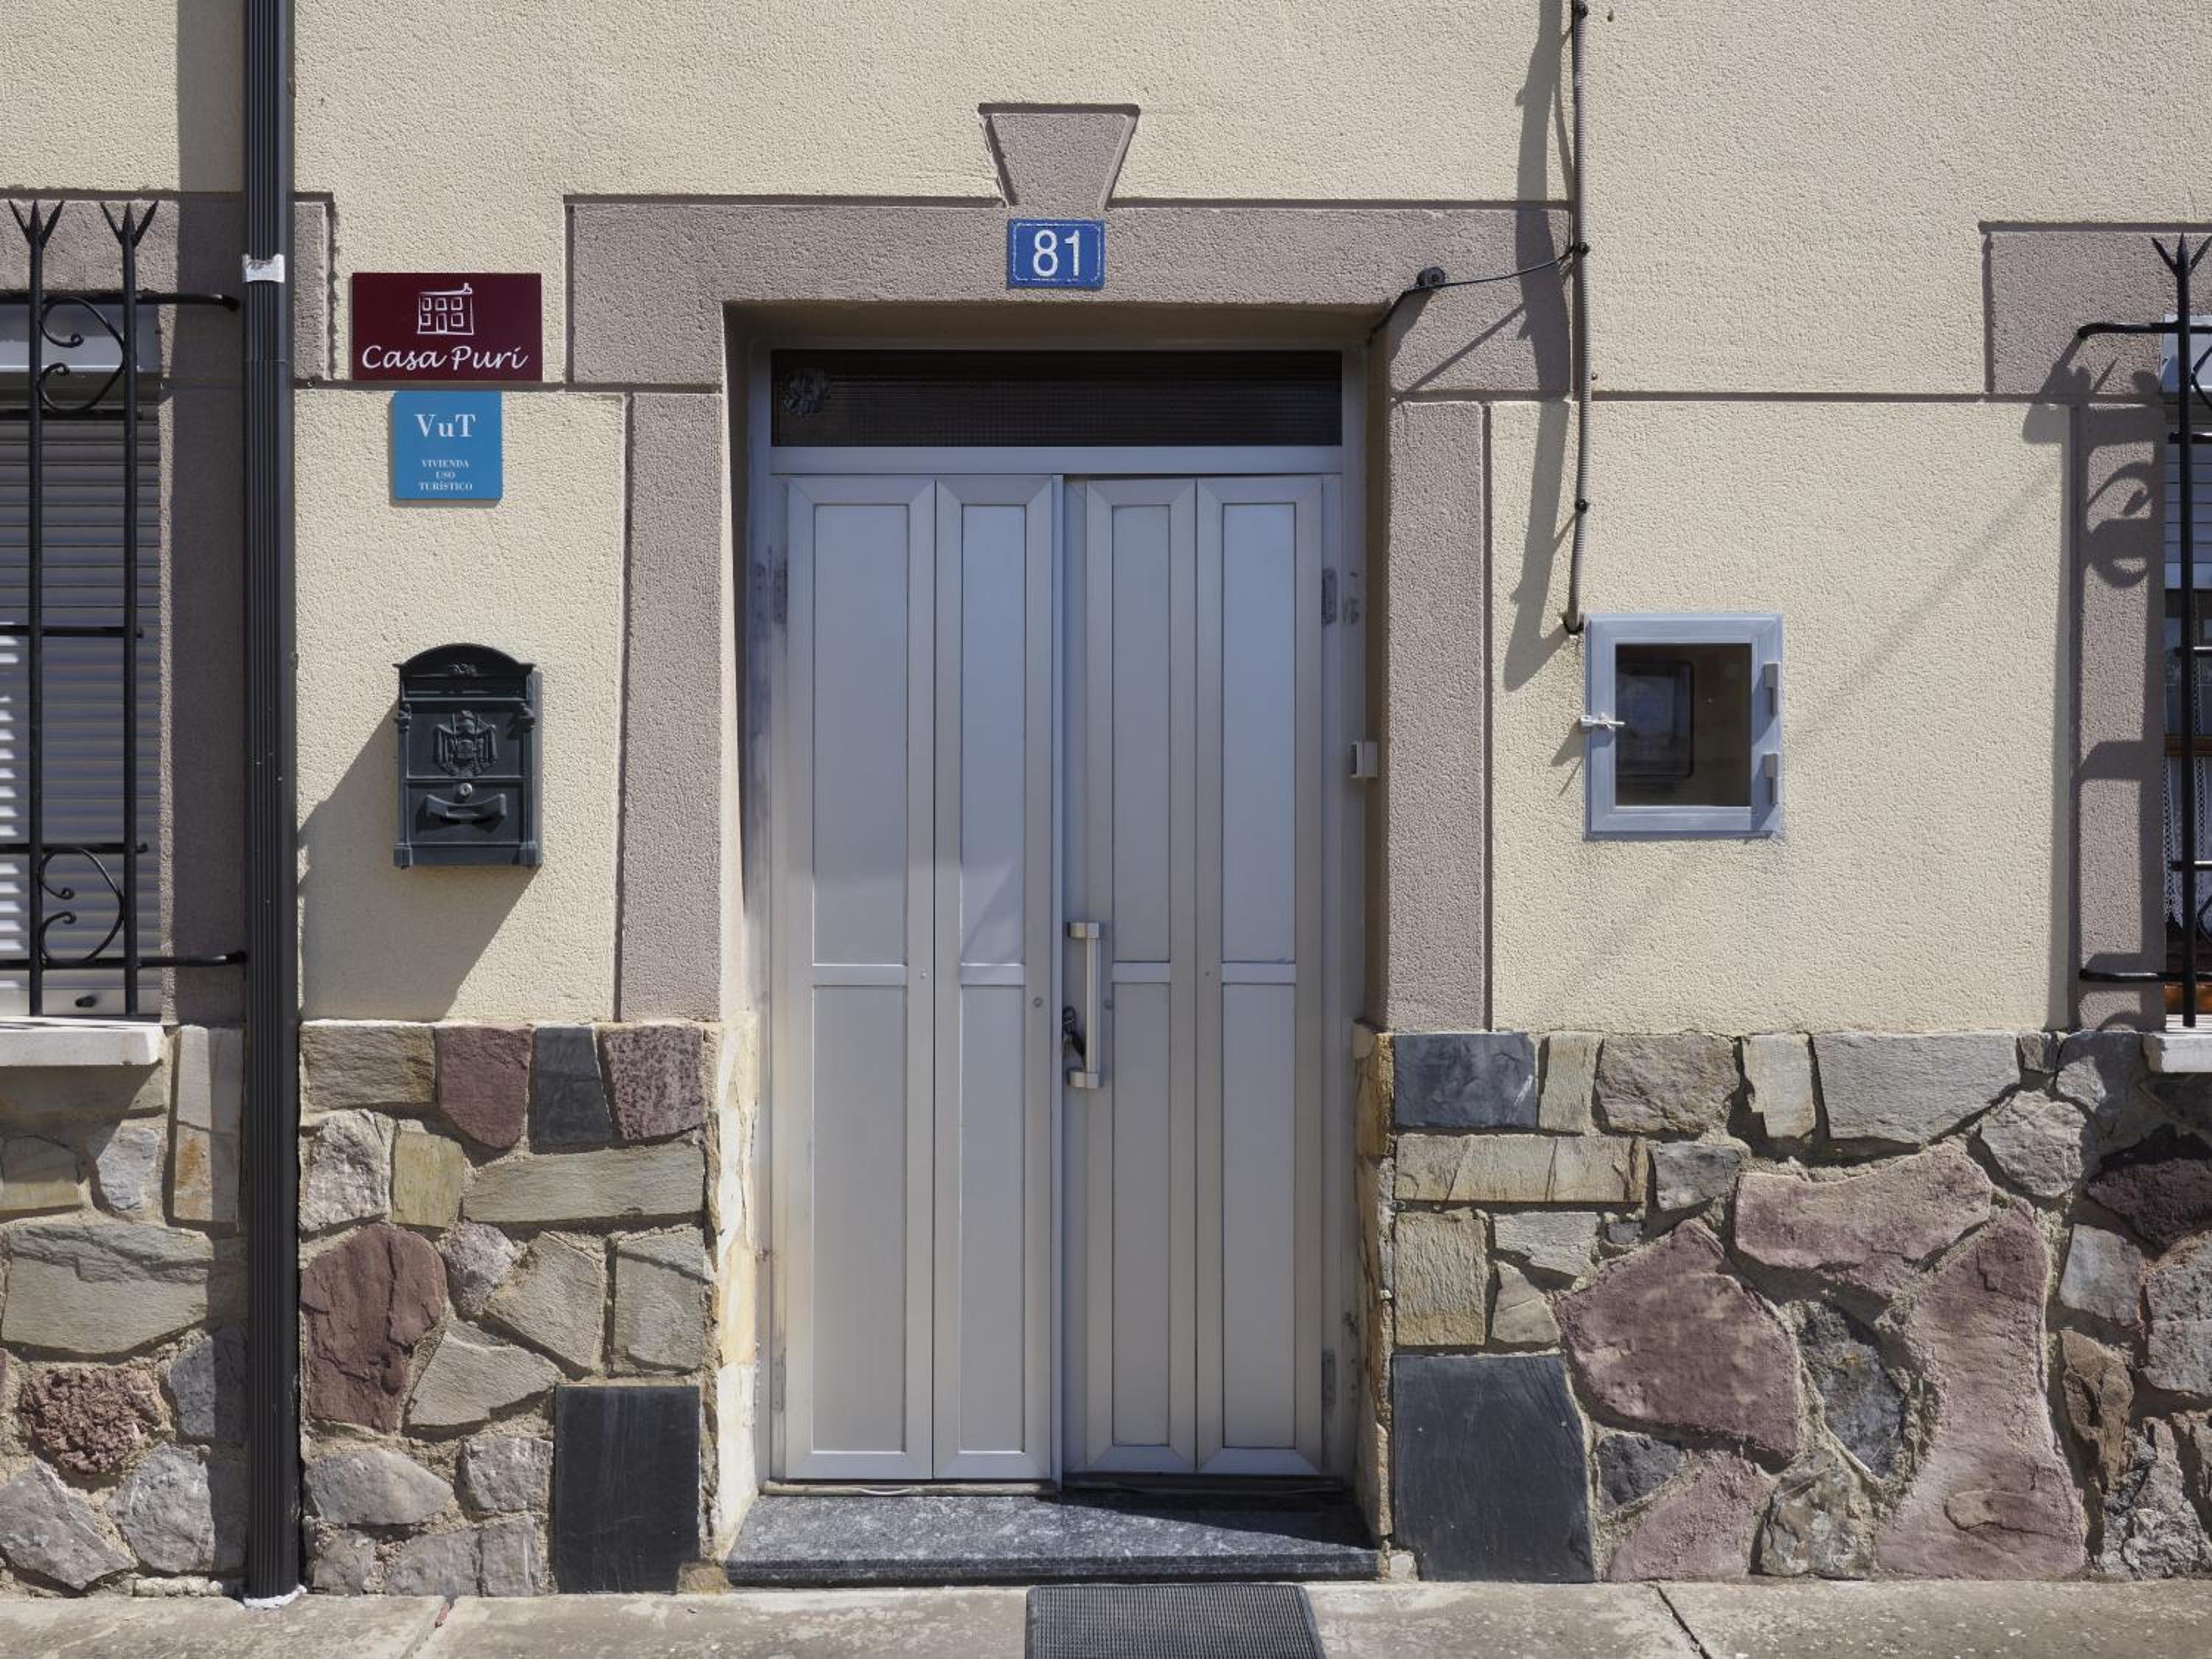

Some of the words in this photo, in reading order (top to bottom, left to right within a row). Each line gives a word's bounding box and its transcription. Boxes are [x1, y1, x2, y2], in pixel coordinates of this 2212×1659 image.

[1033, 229, 1080, 277] 81
[361, 344, 447, 371] Casa
[414, 413, 476, 437] VuT
[421, 459, 470, 468] VIVIENDA
[435, 471, 456, 479] USO
